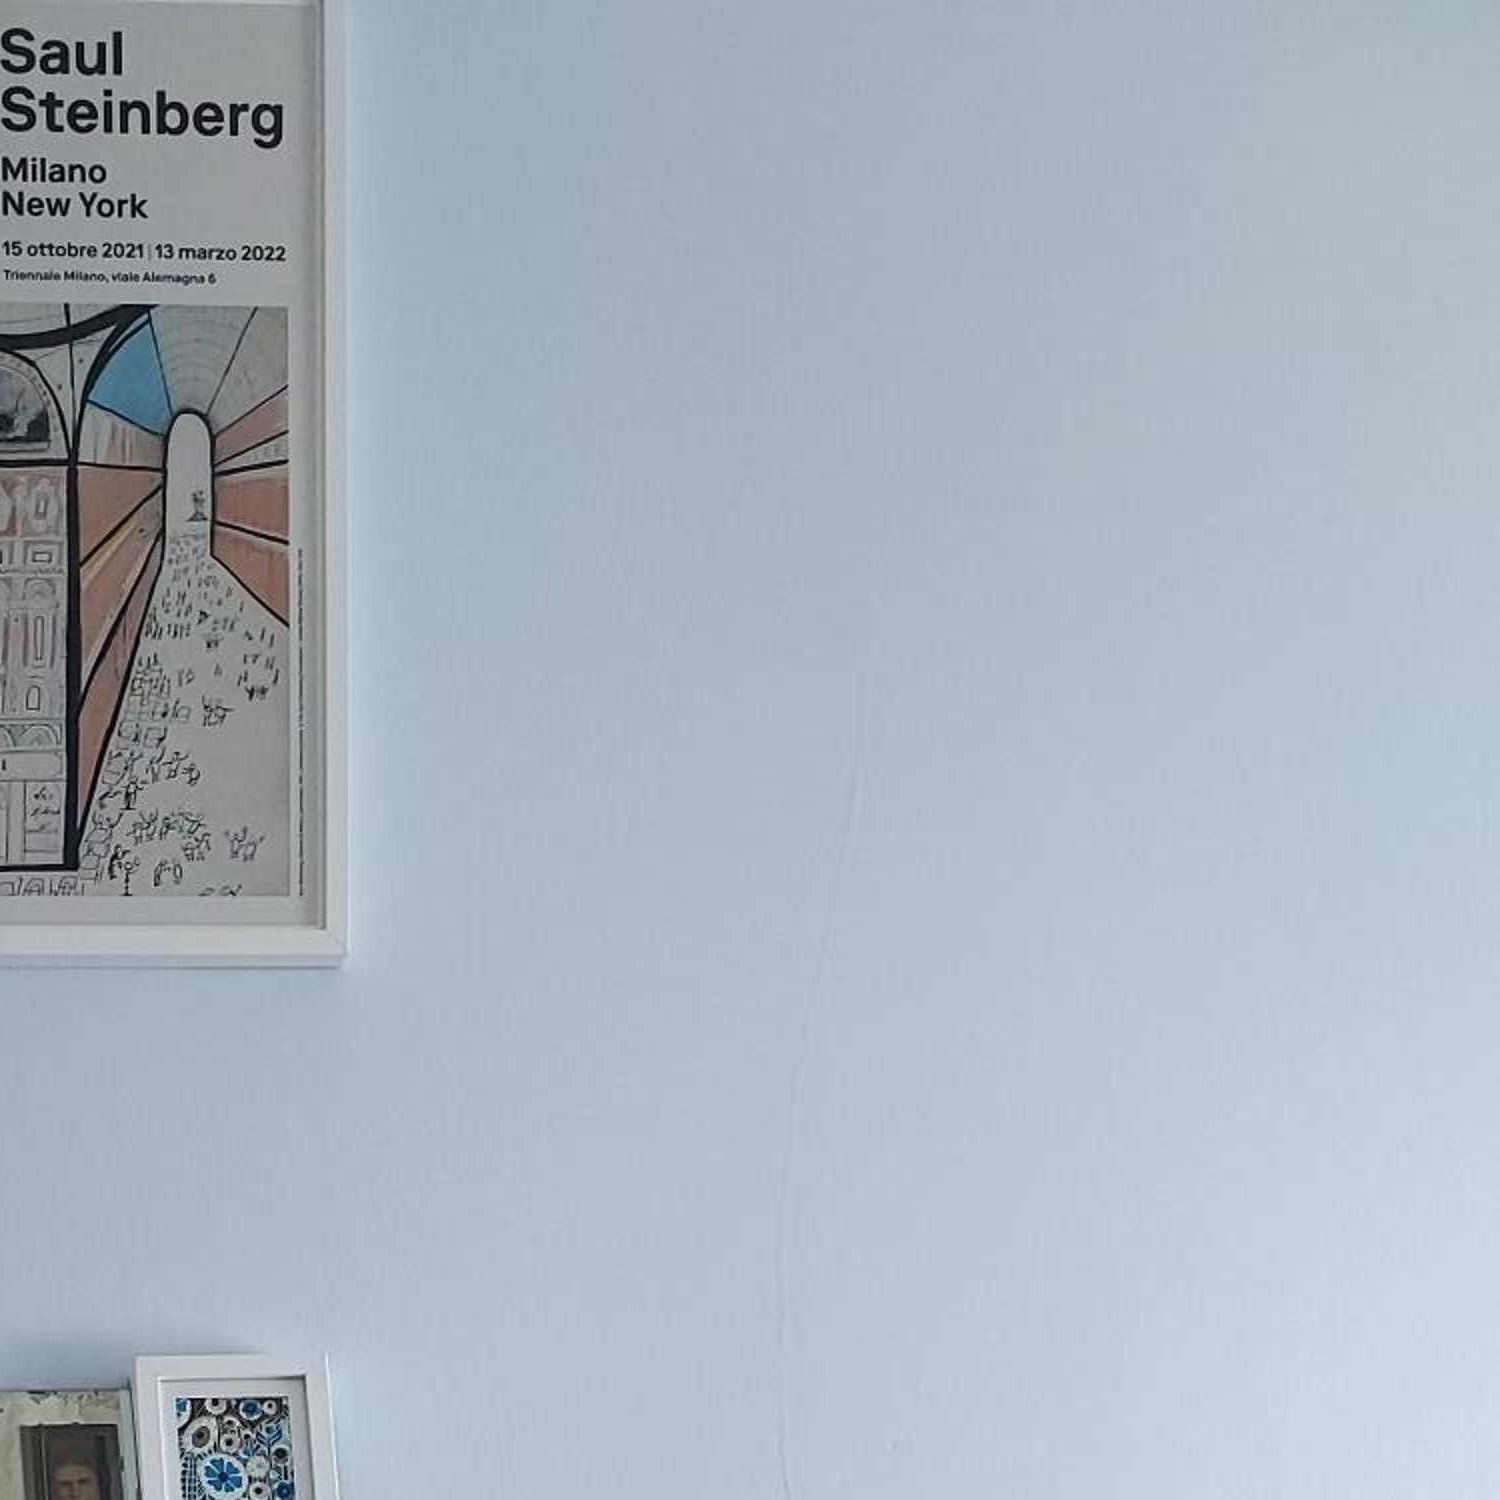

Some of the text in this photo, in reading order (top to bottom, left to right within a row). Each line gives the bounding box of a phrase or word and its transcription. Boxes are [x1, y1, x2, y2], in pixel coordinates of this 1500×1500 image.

[0, 27, 123, 77] Saul
[0, 85, 285, 150] Steinberg
[1, 155, 108, 185] Milano
[1, 189, 150, 219] New York
[2, 240, 287, 262] 15 ottobre 2021 13 marzo 2022
[3, 269, 218, 287] Triennale Milano, viale Alemagna 6
